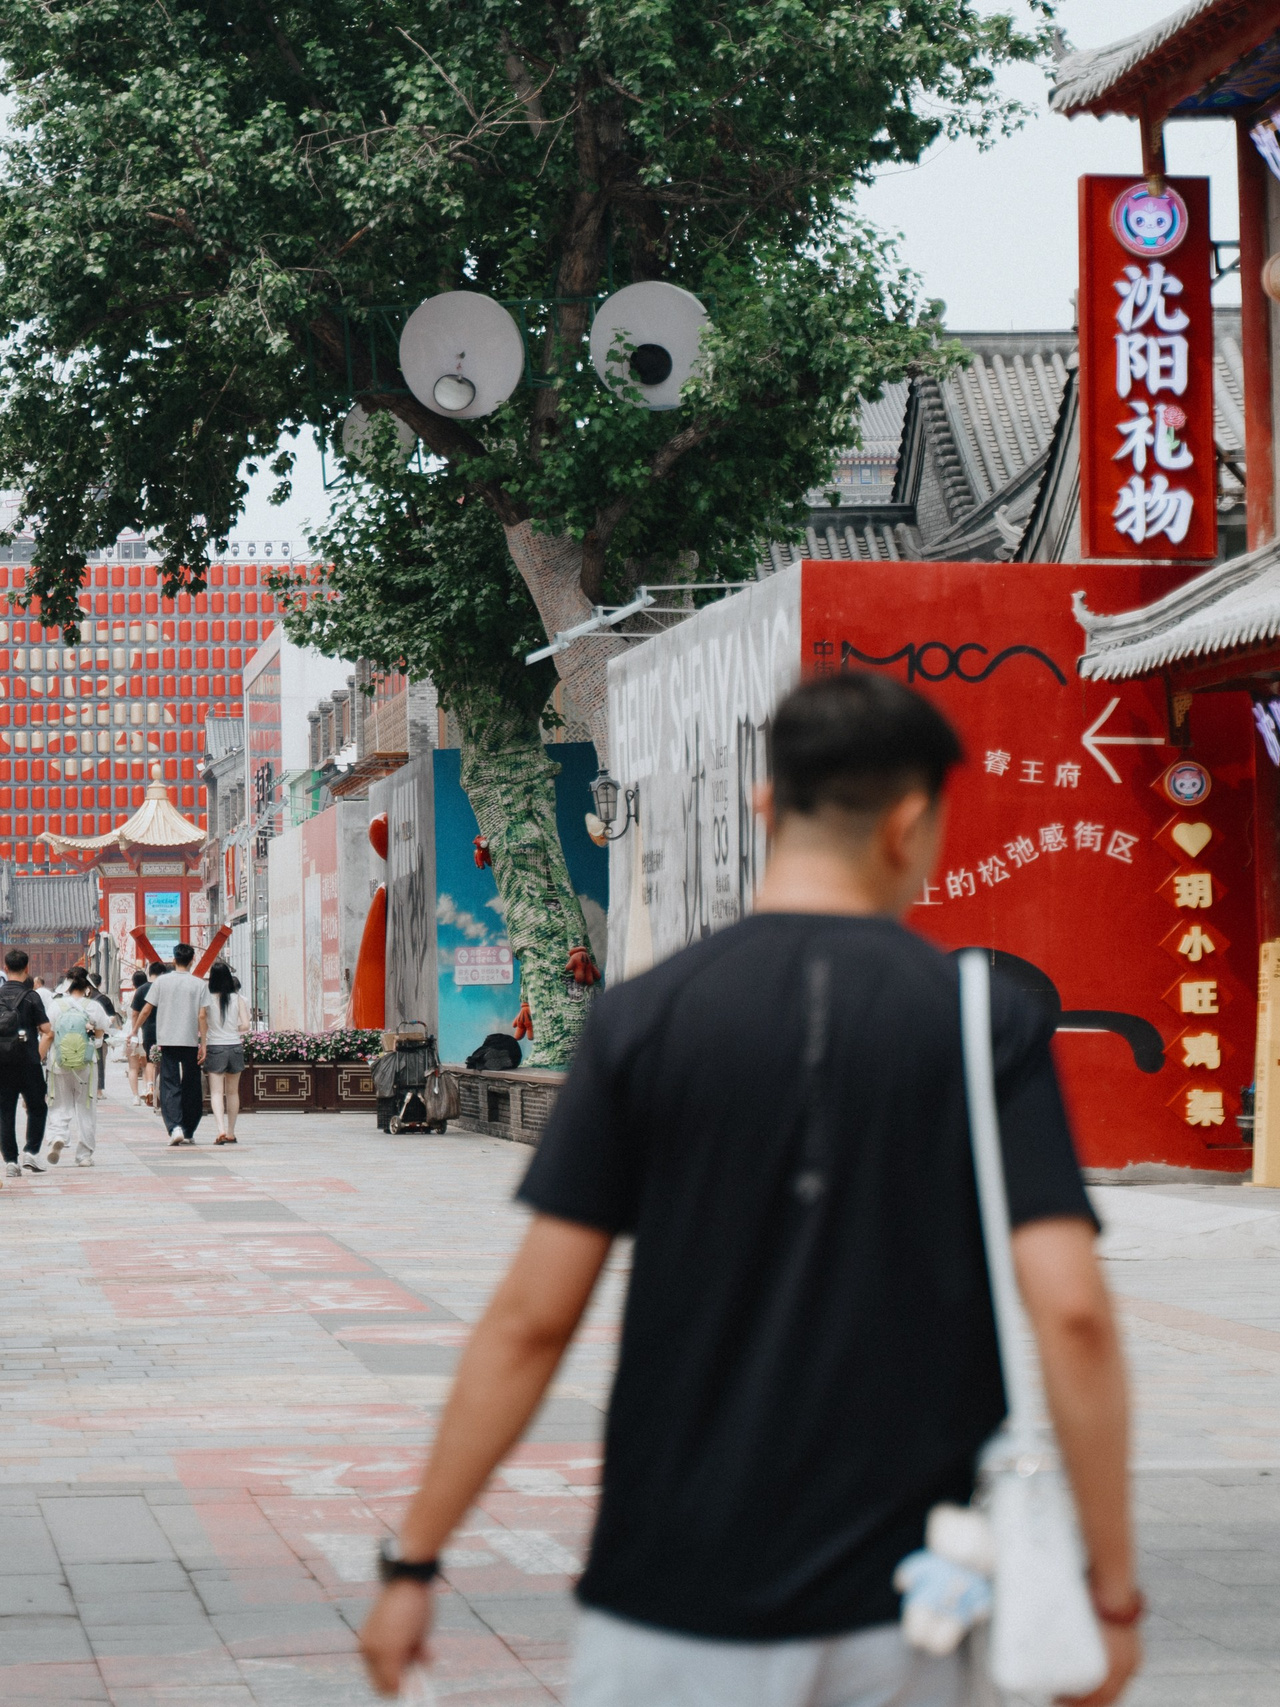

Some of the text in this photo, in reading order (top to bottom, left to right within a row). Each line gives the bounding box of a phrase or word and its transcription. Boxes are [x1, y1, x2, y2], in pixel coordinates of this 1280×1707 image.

[1112, 262, 1194, 544] 沈阳礼物
[983, 748, 1083, 789] 睿王府
[912, 819, 1140, 906] 上的松弛感街区
